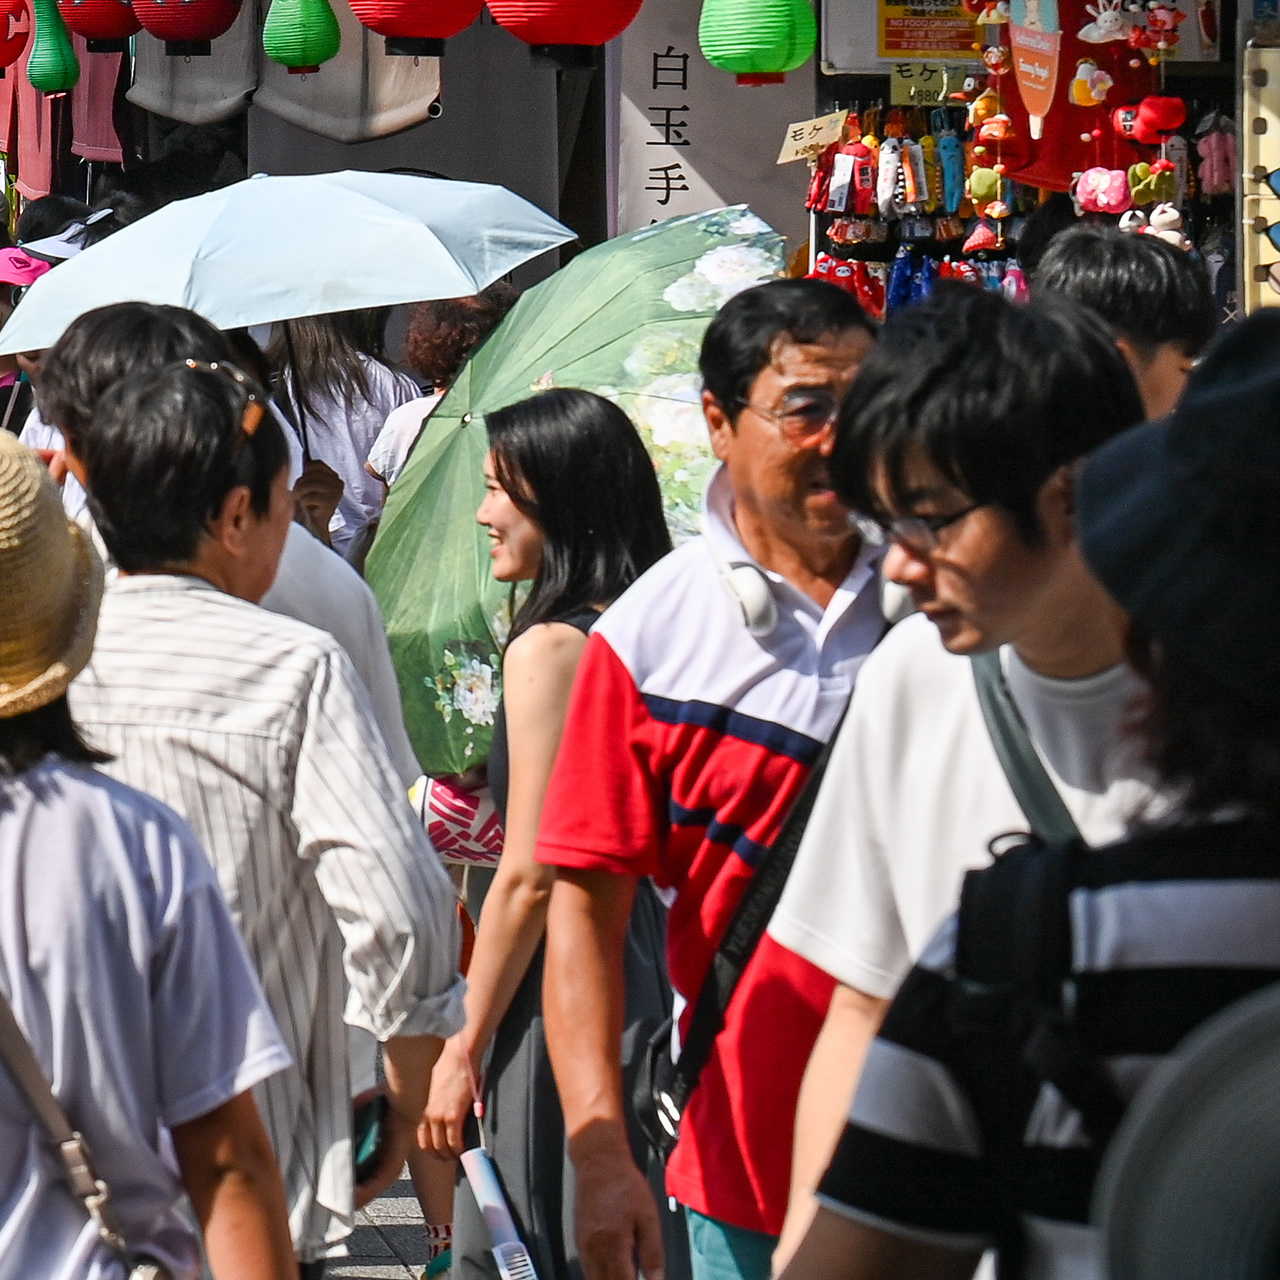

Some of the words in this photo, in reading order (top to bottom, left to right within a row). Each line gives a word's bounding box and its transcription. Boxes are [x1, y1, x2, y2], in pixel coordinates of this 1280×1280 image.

[889, 19, 903, 27] NO
[905, 19, 929, 27] FOOD
[644, 45, 692, 223] 白玉手
